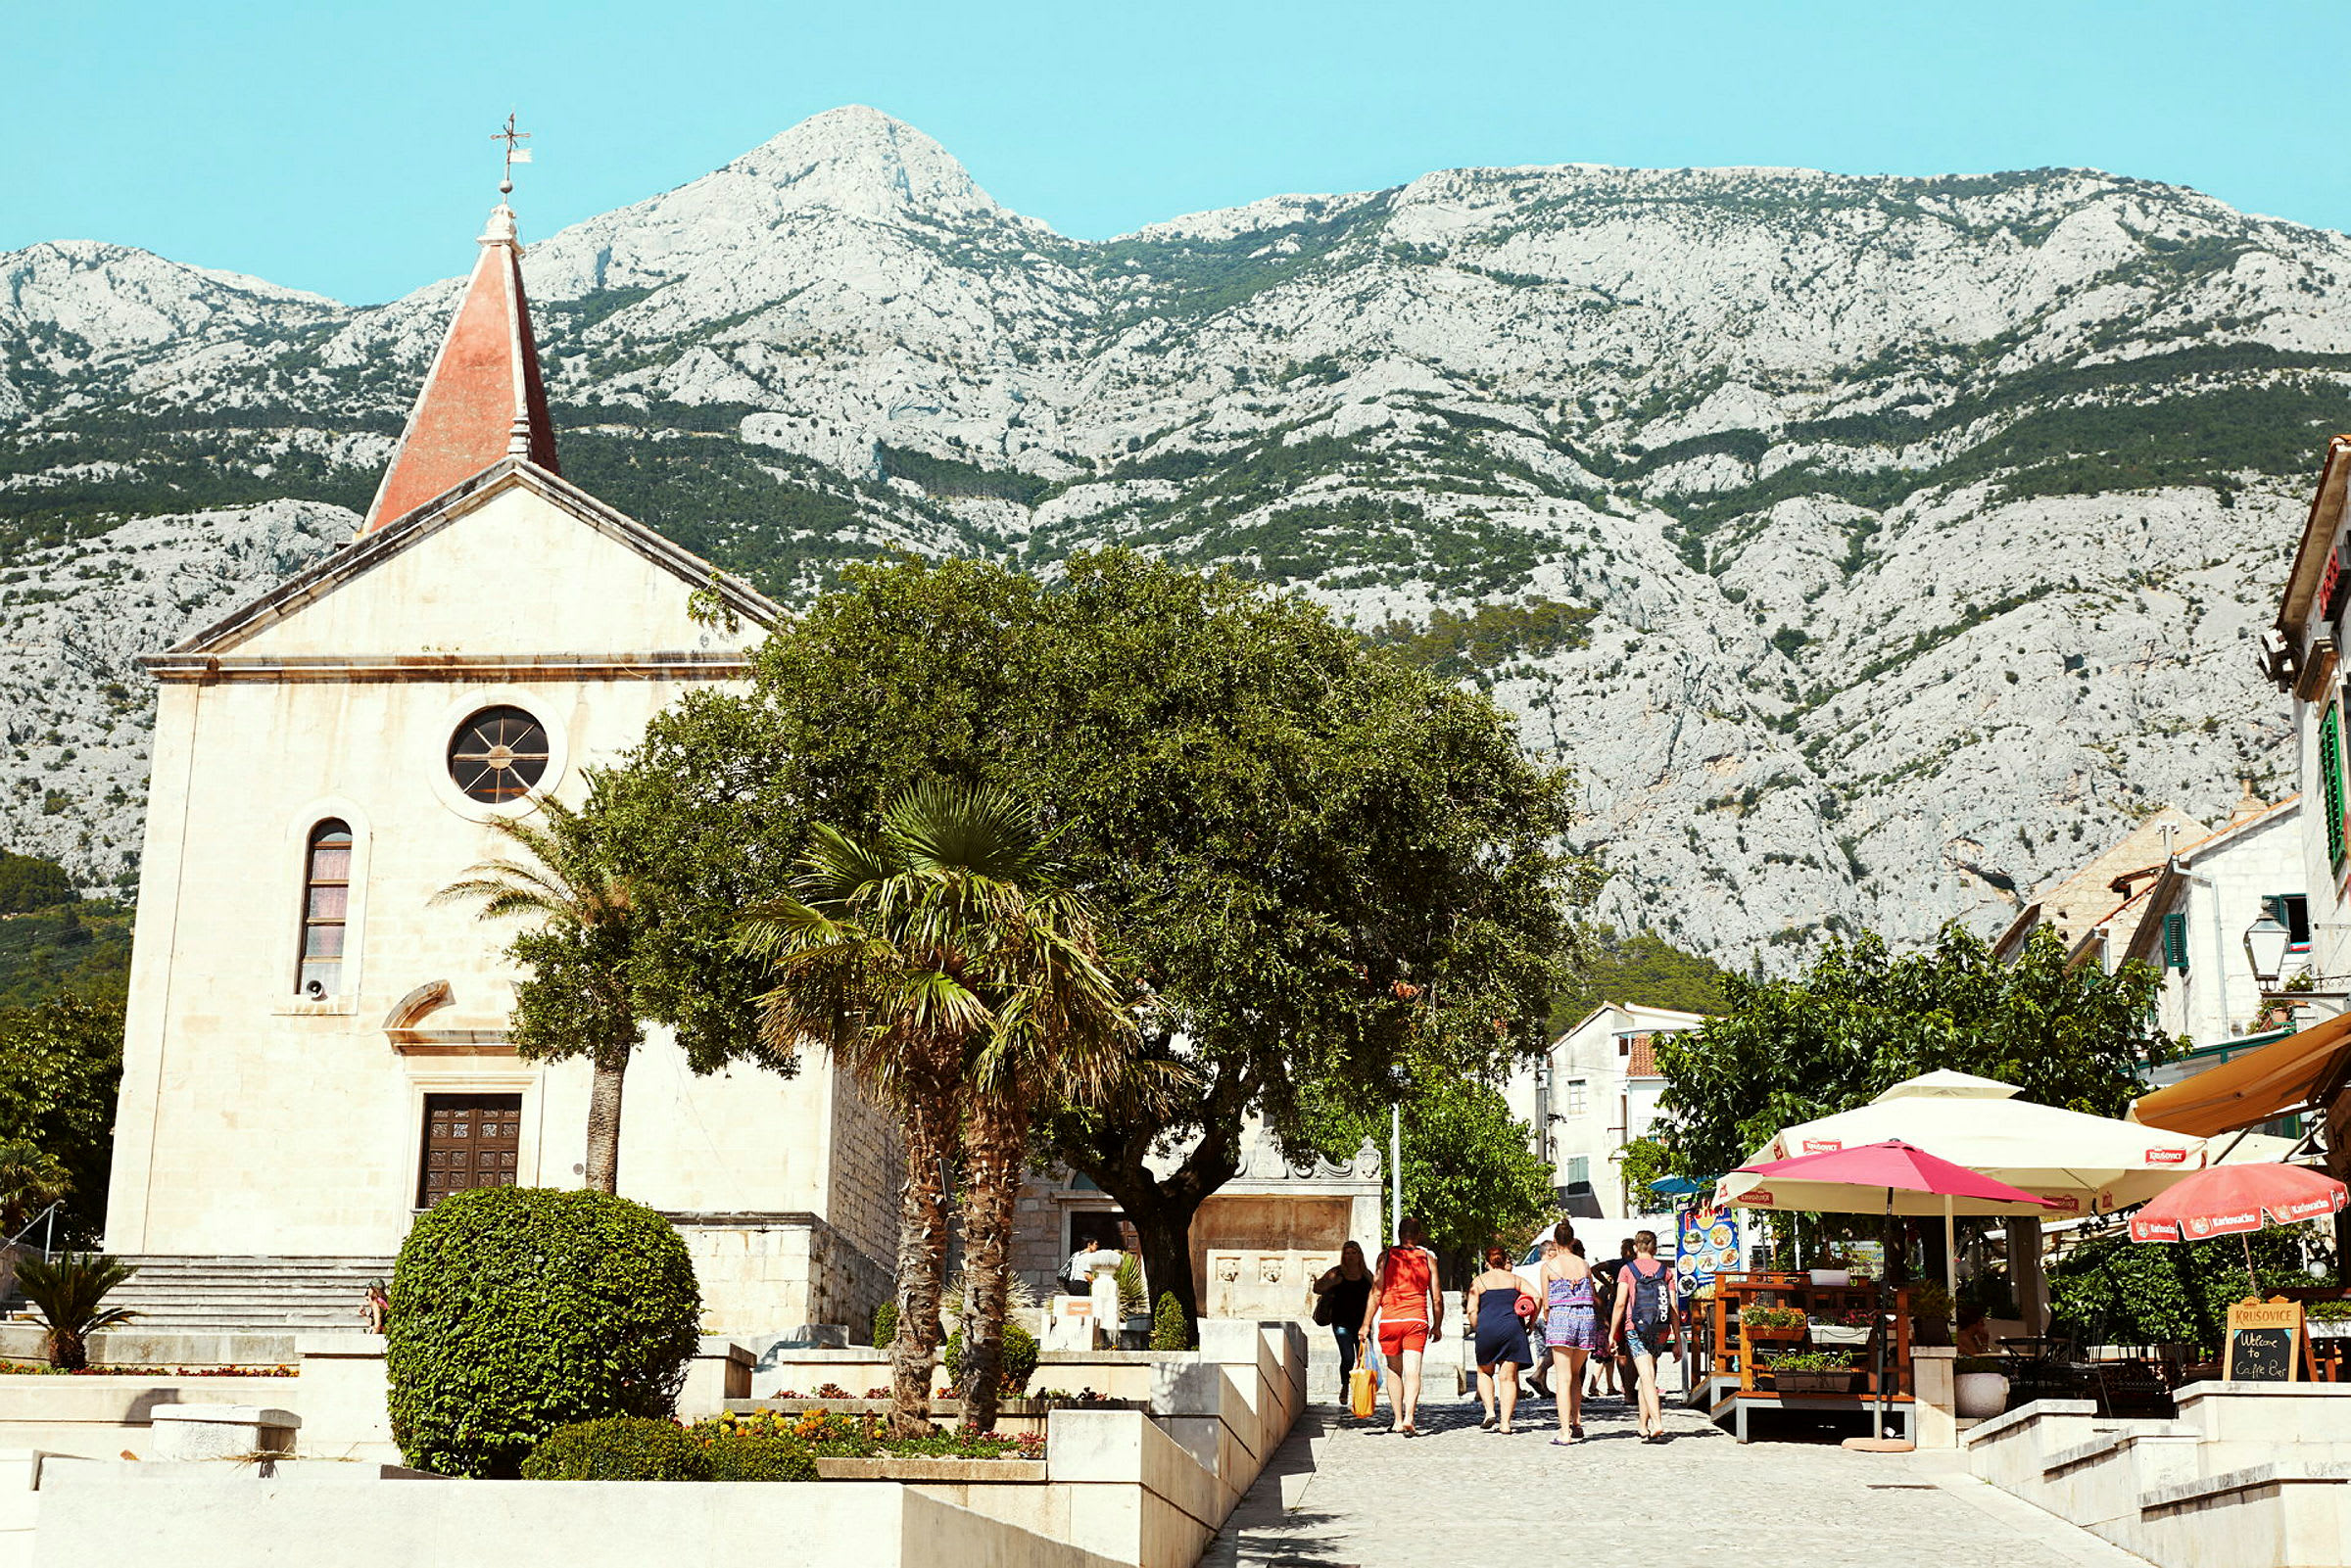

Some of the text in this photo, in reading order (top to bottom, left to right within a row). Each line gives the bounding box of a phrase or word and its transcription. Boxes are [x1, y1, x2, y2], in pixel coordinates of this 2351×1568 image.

[1657, 1284, 1668, 1323] adidas
[2240, 1333, 2279, 1348] Welcome
[2247, 1347, 2260, 1358] to
